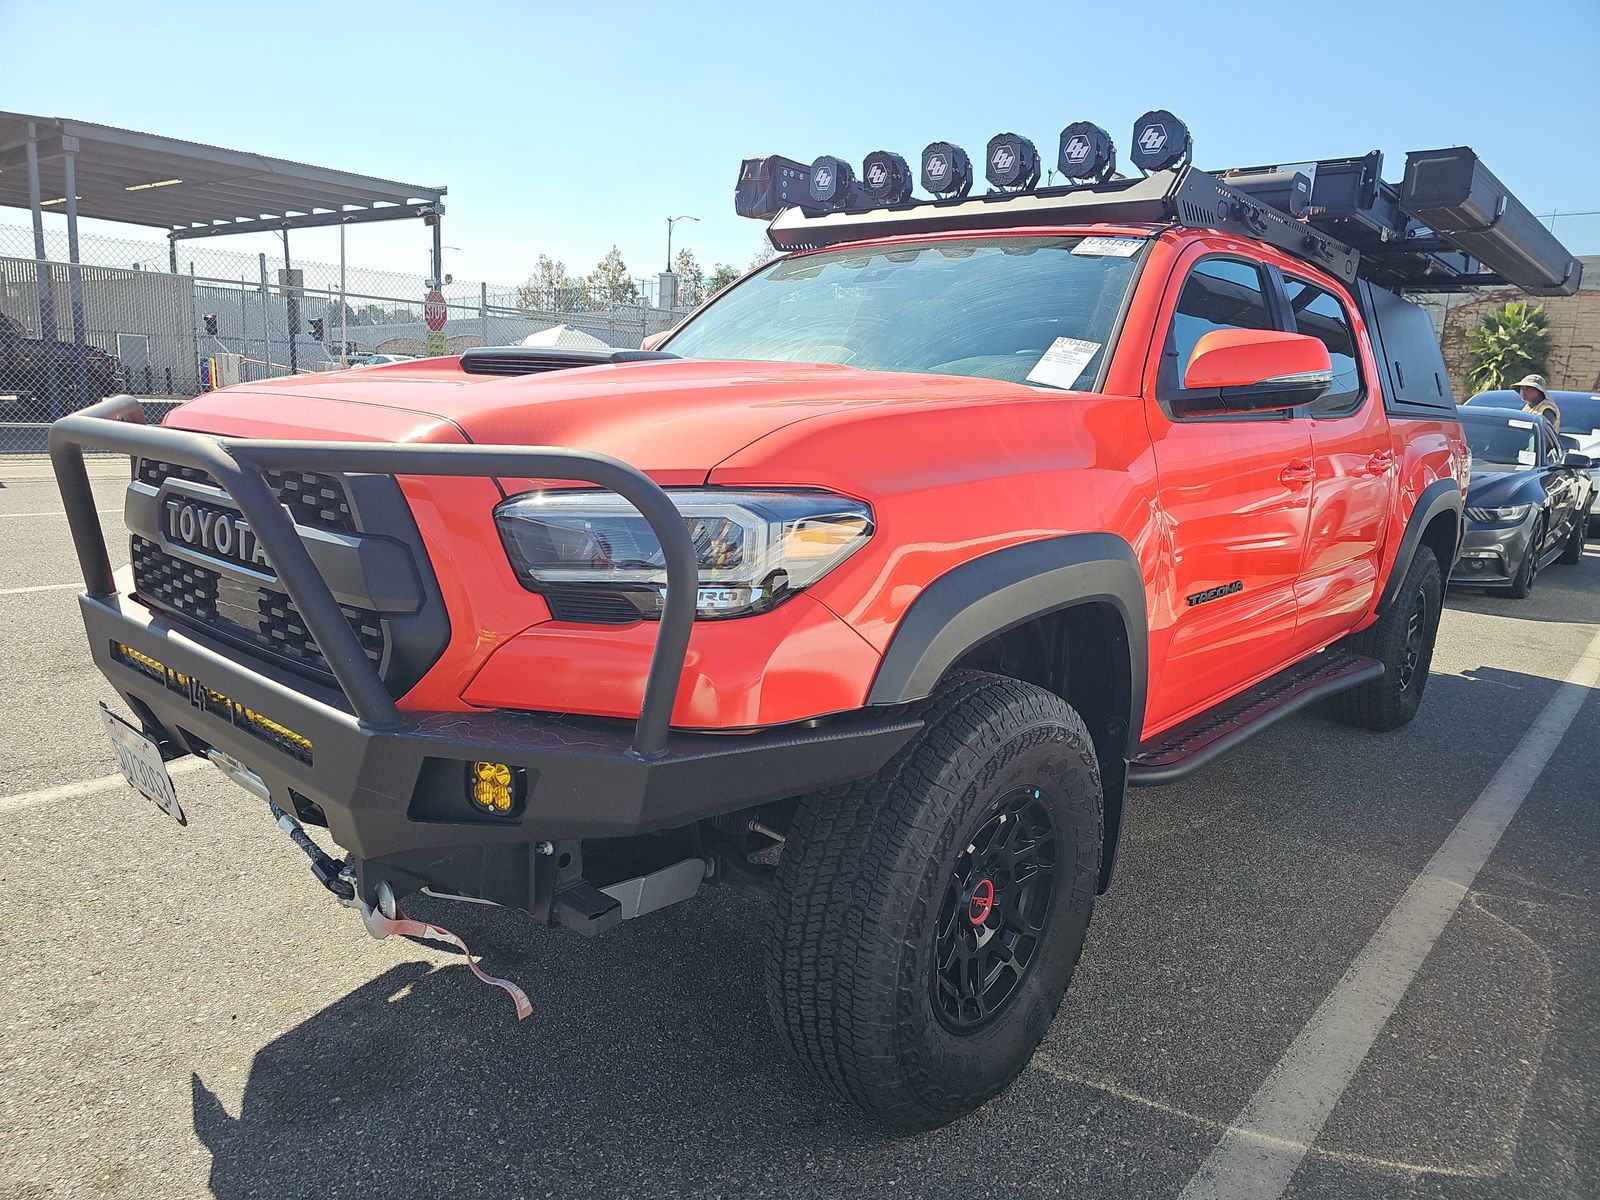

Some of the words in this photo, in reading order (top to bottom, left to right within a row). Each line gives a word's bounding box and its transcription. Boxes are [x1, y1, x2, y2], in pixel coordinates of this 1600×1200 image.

[425, 303, 446, 319] STOP
[1056, 337, 1099, 350] 3704401
[1187, 580, 1244, 606] TACOMA
